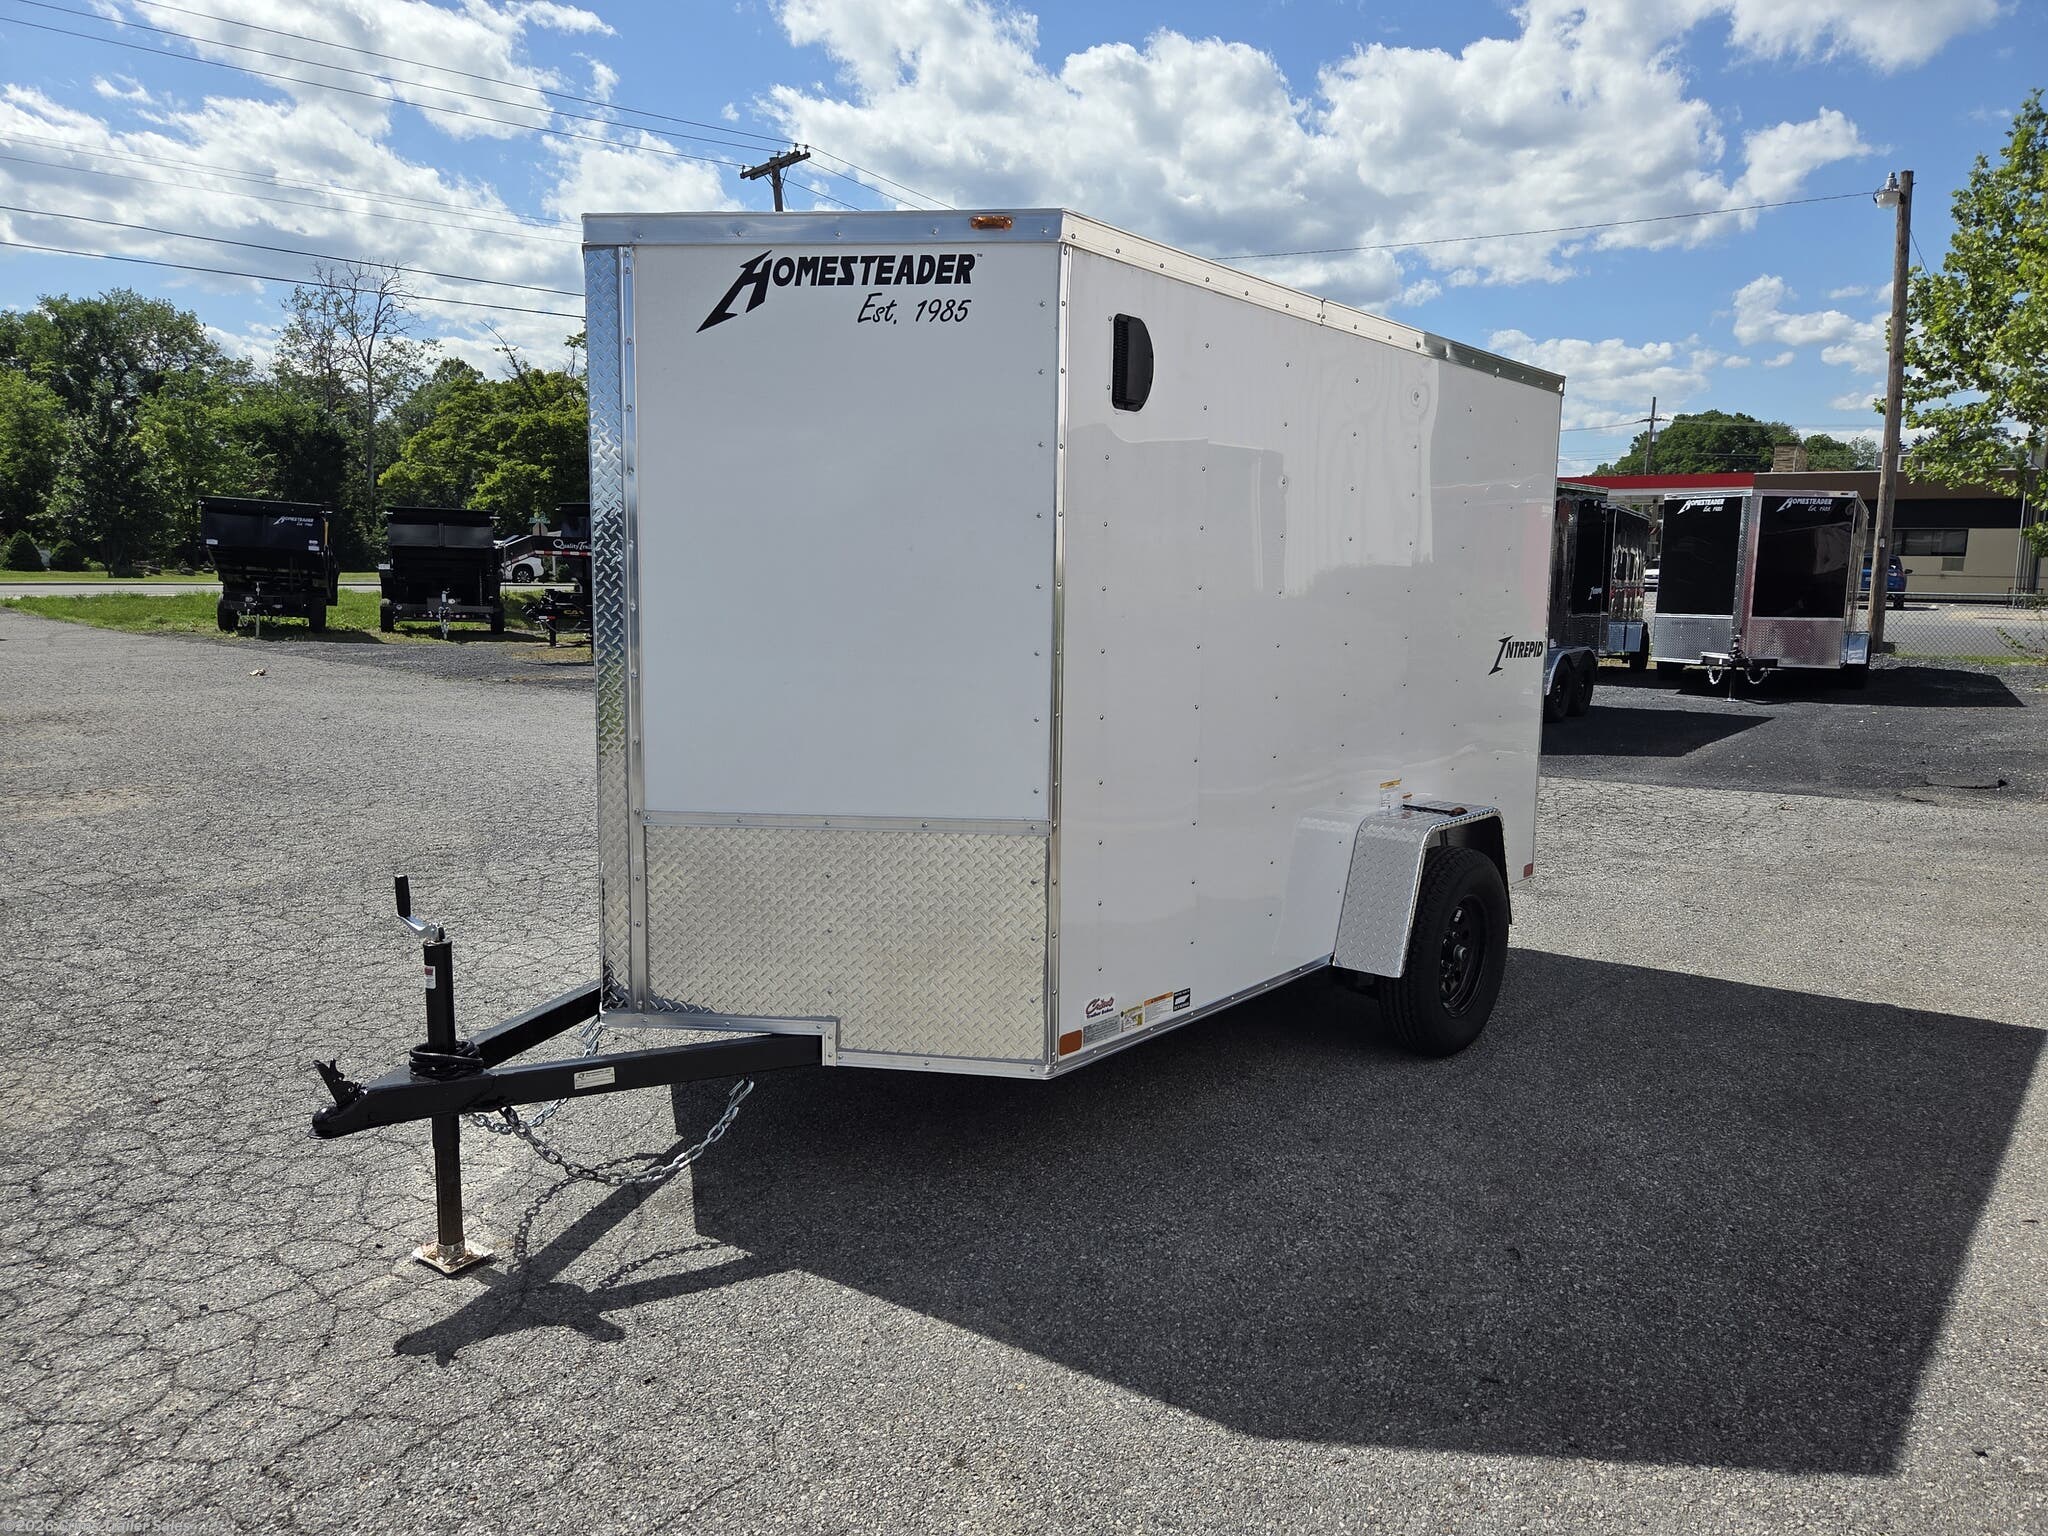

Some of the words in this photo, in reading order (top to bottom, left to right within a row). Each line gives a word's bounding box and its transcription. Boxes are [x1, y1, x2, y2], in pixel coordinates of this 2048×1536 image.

[696, 250, 977, 333] HOMESTEADER
[857, 292, 897, 325] Est.
[915, 299, 972, 322] 1985
